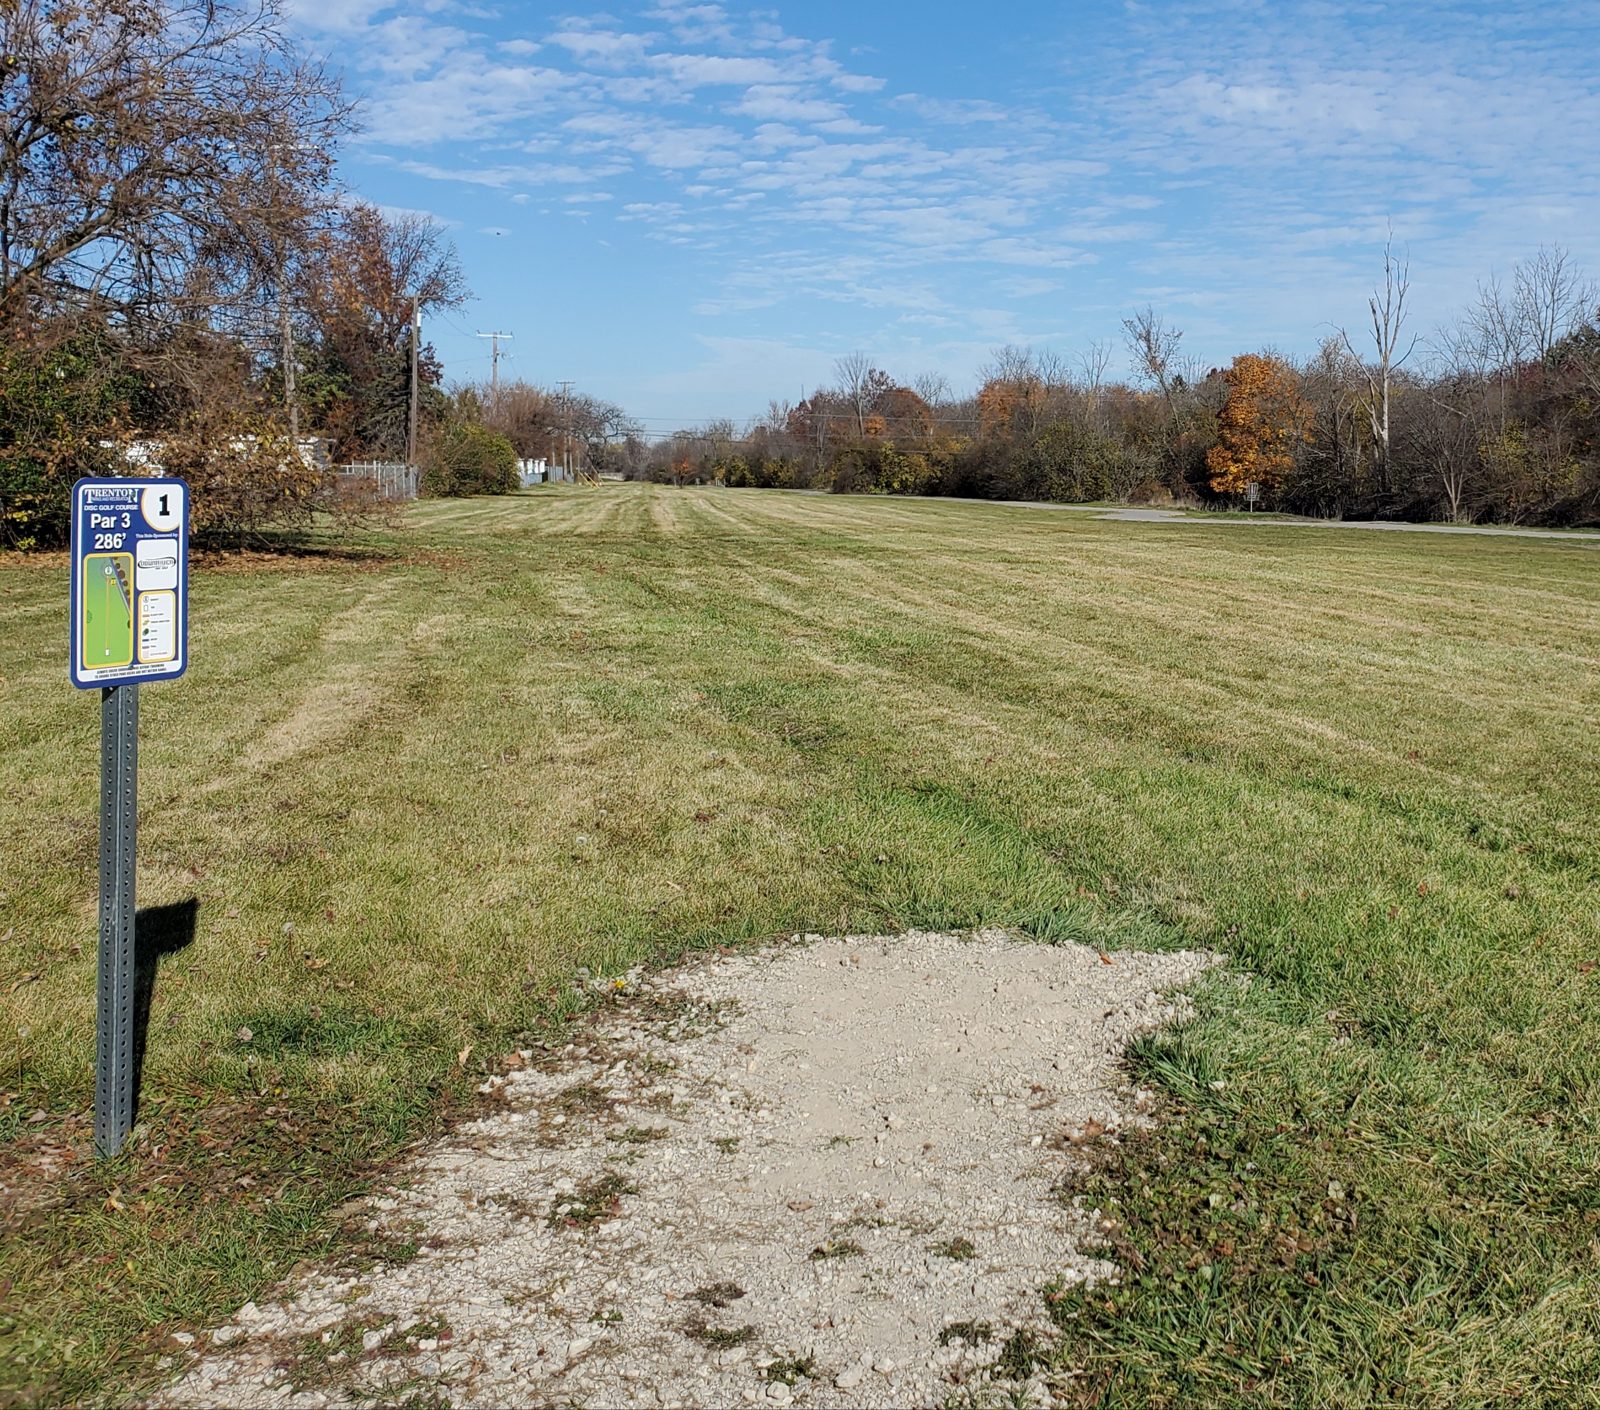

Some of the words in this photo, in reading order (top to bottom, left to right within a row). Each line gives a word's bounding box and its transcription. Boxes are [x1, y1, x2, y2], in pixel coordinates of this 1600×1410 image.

[85, 489, 139, 503] TRENTON
[159, 494, 170, 516] 1
[90, 513, 117, 529] Par
[121, 512, 130, 528] 3
